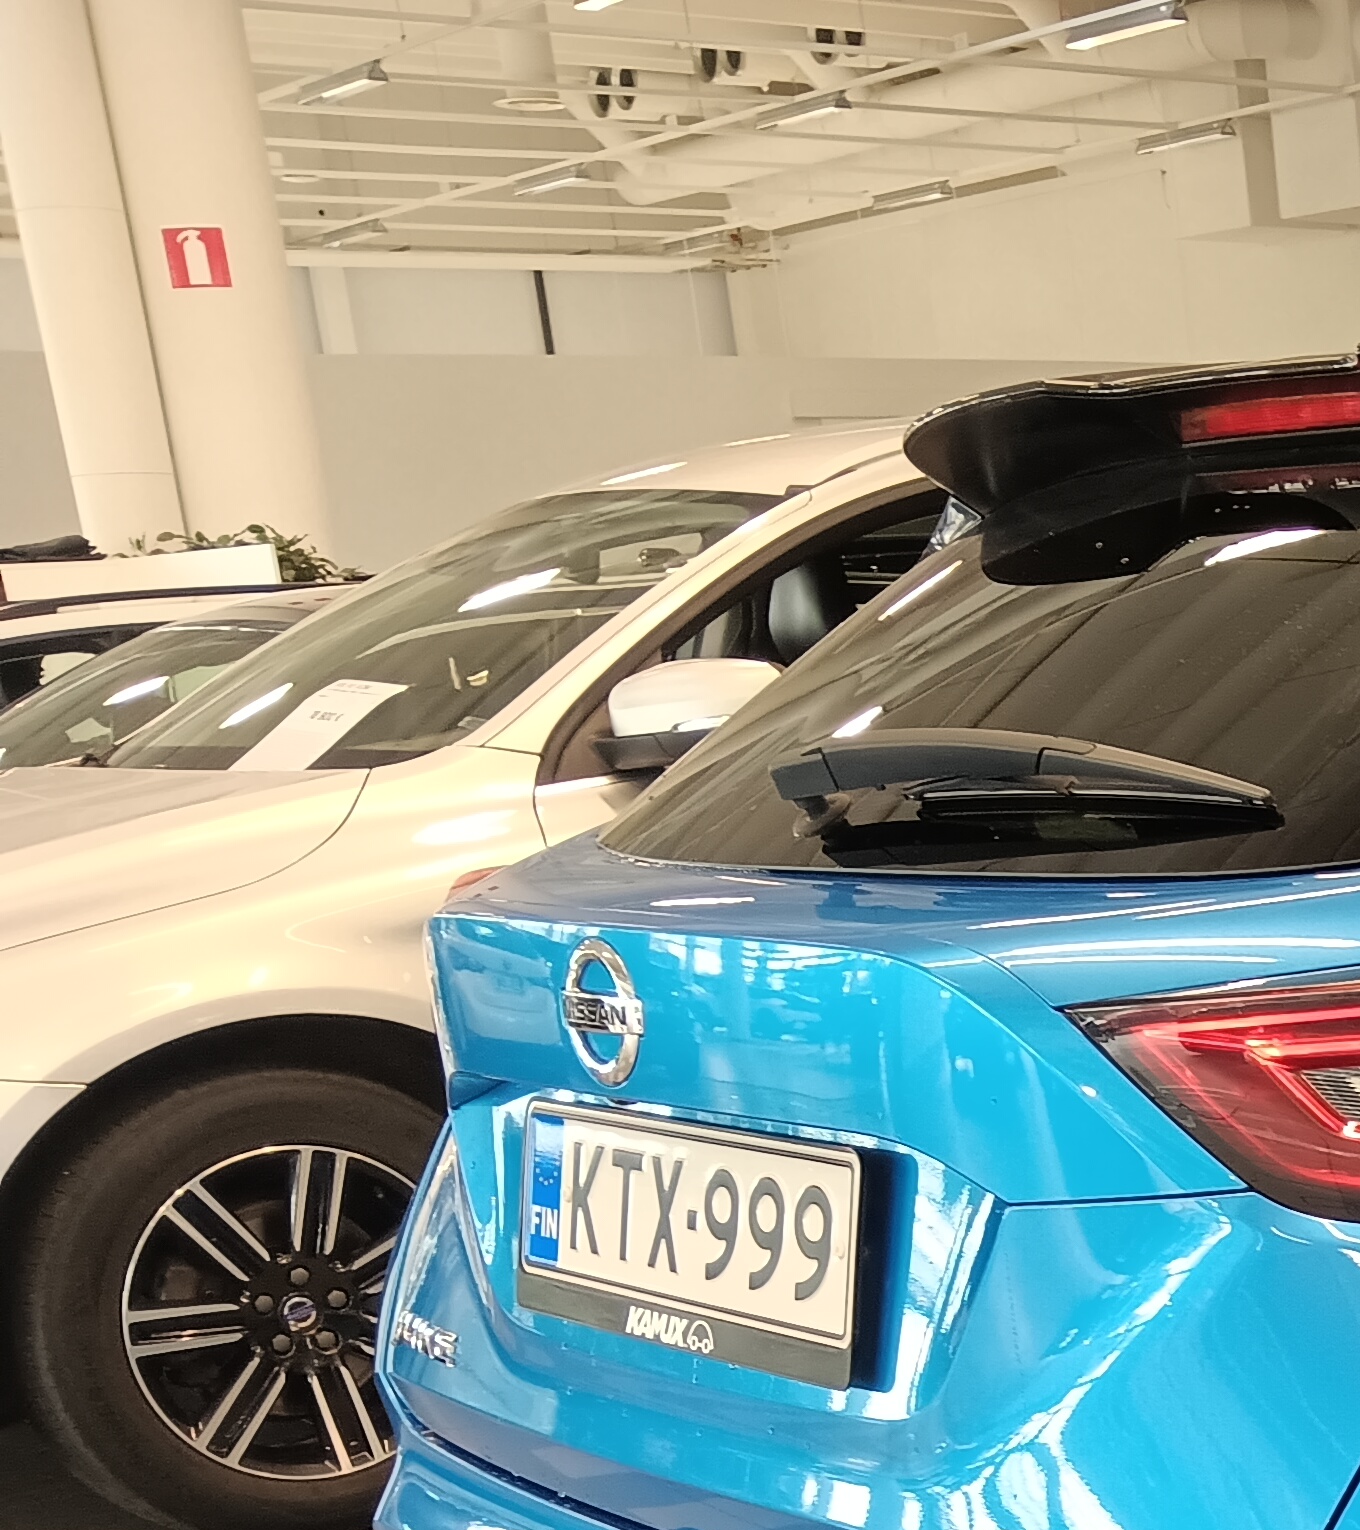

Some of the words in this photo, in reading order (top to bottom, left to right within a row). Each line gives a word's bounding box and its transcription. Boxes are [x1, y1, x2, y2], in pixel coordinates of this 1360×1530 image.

[530, 1204, 558, 1240] FIN
[569, 1141, 833, 1302] KTX-999
[625, 1305, 688, 1348] KAMUX
